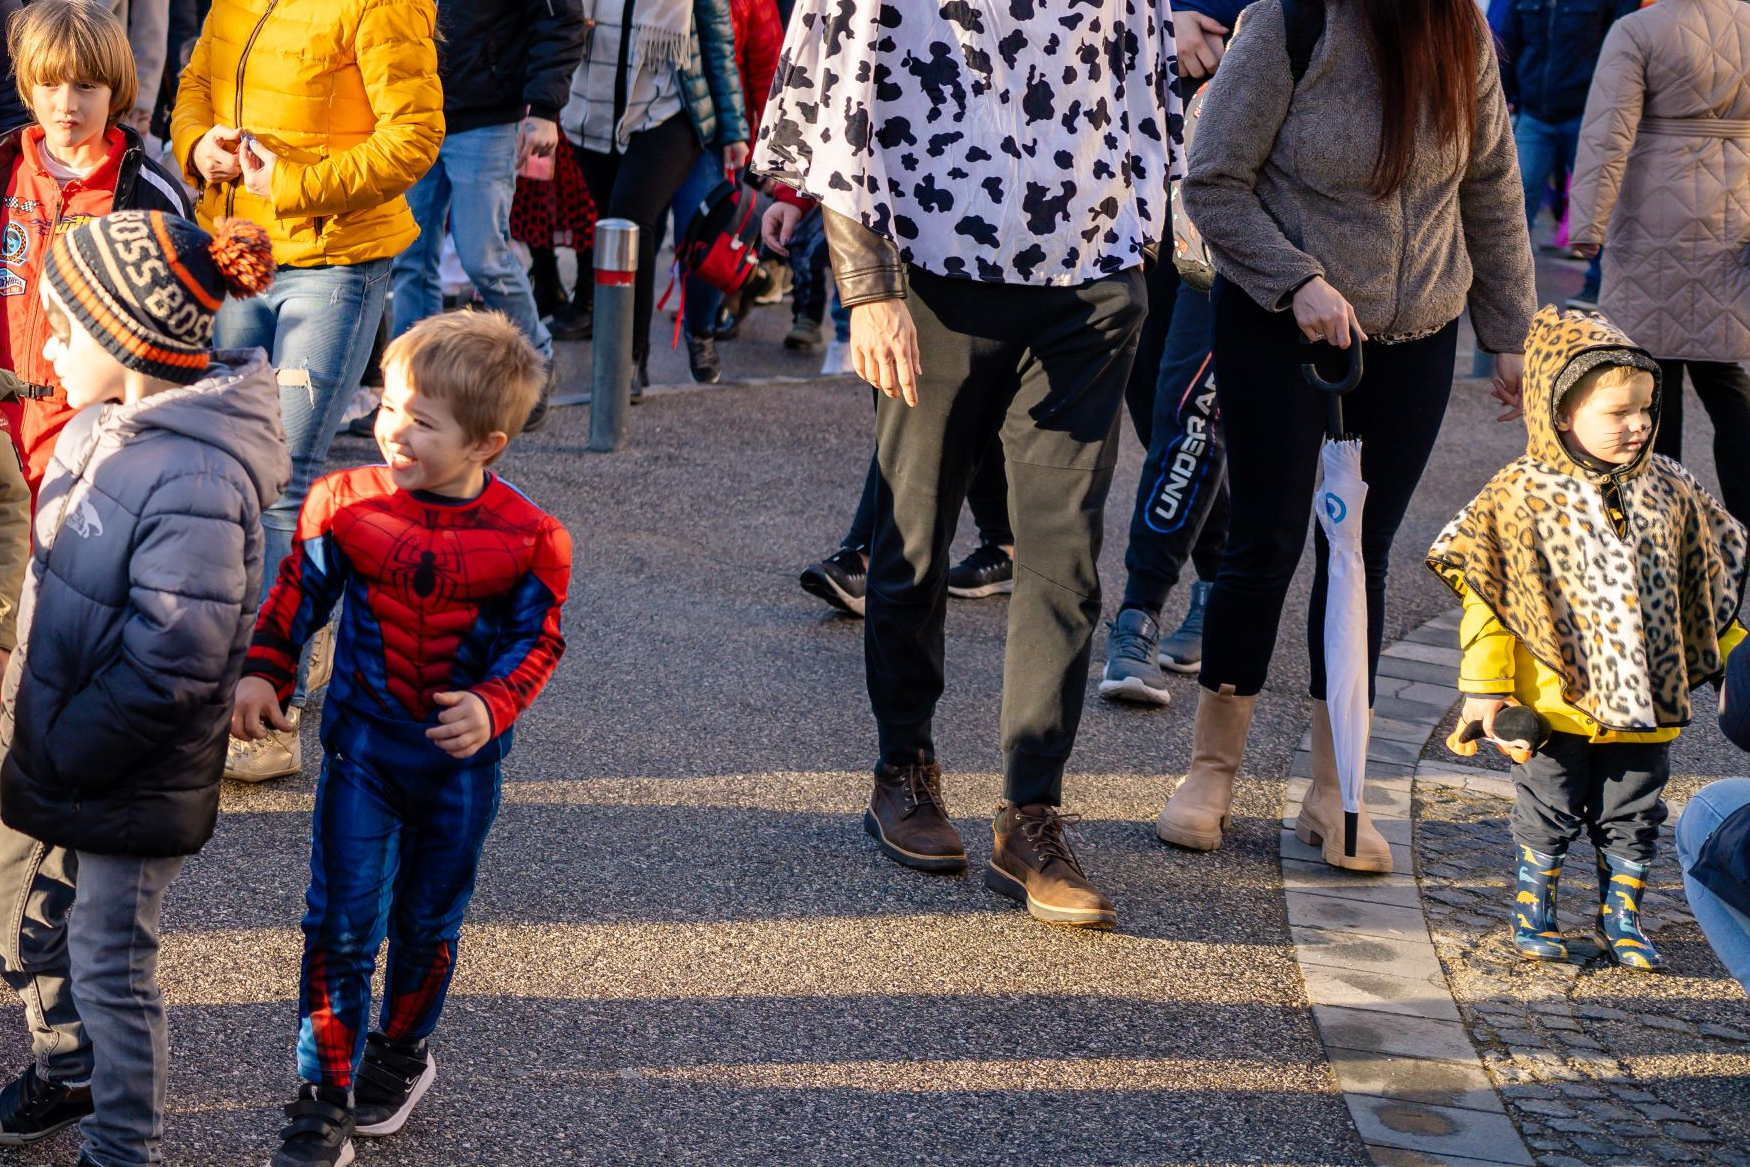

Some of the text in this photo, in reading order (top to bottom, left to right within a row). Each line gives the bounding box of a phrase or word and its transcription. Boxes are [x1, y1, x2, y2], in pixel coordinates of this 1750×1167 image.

[107, 210, 169, 288] BOSS
[144, 282, 216, 344] BOS
[1155, 414, 1208, 521] UNDER
